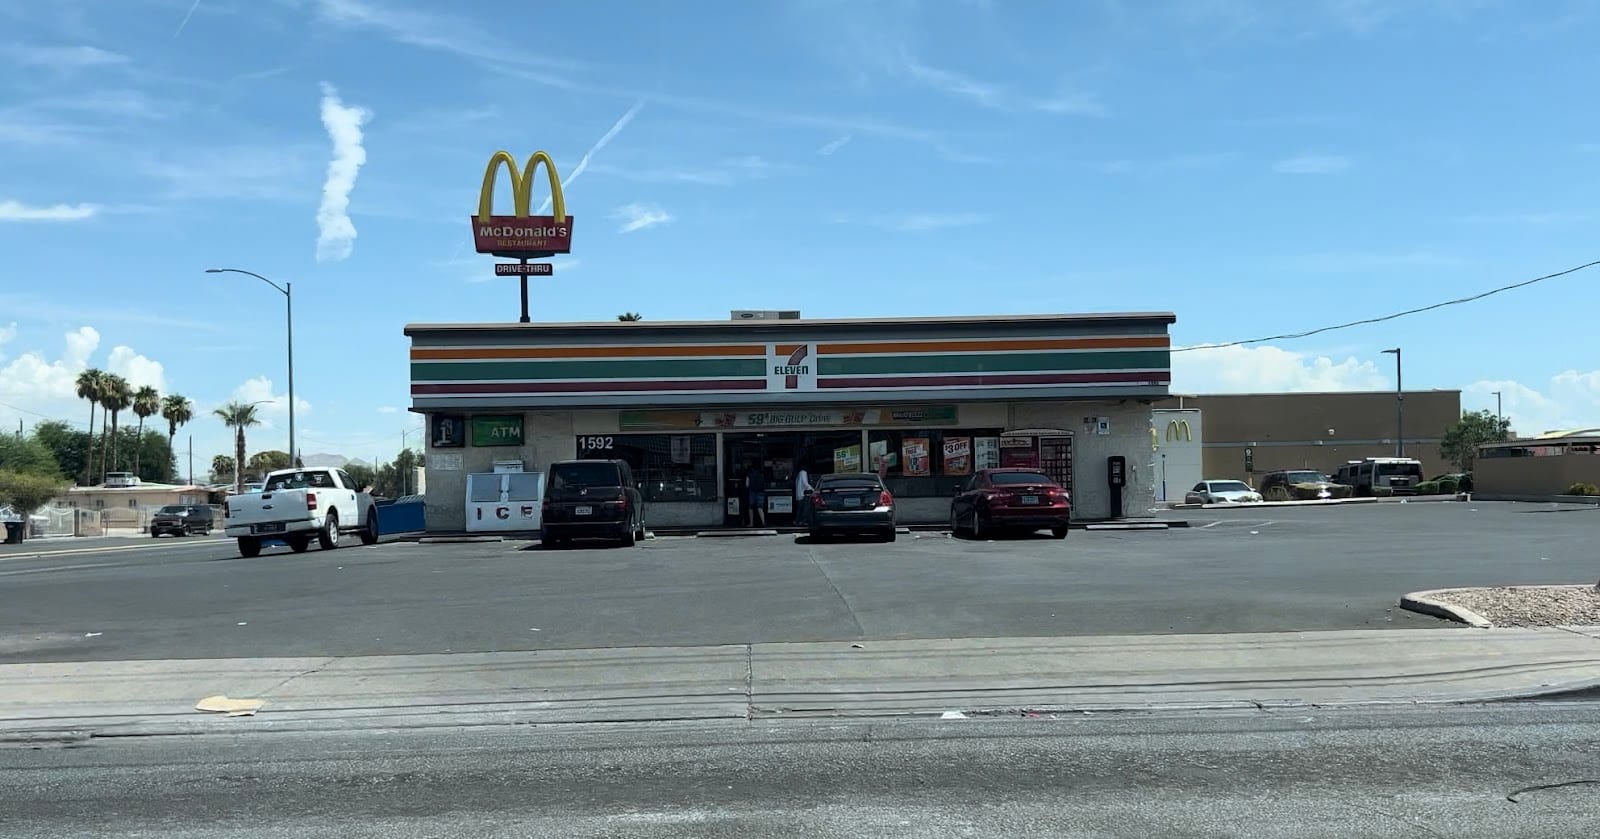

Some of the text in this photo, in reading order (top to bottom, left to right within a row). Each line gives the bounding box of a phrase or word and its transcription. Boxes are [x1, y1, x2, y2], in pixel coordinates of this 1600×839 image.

[480, 226, 567, 238] McDonald's
[496, 264, 550, 273] DRIVE-THRU
[785, 344, 808, 388] 7
[770, 415, 784, 424] BIG
[491, 426, 521, 438] ATM
[579, 436, 614, 450] 1592
[954, 441, 968, 451] OFF
[476, 505, 533, 521] ICE
